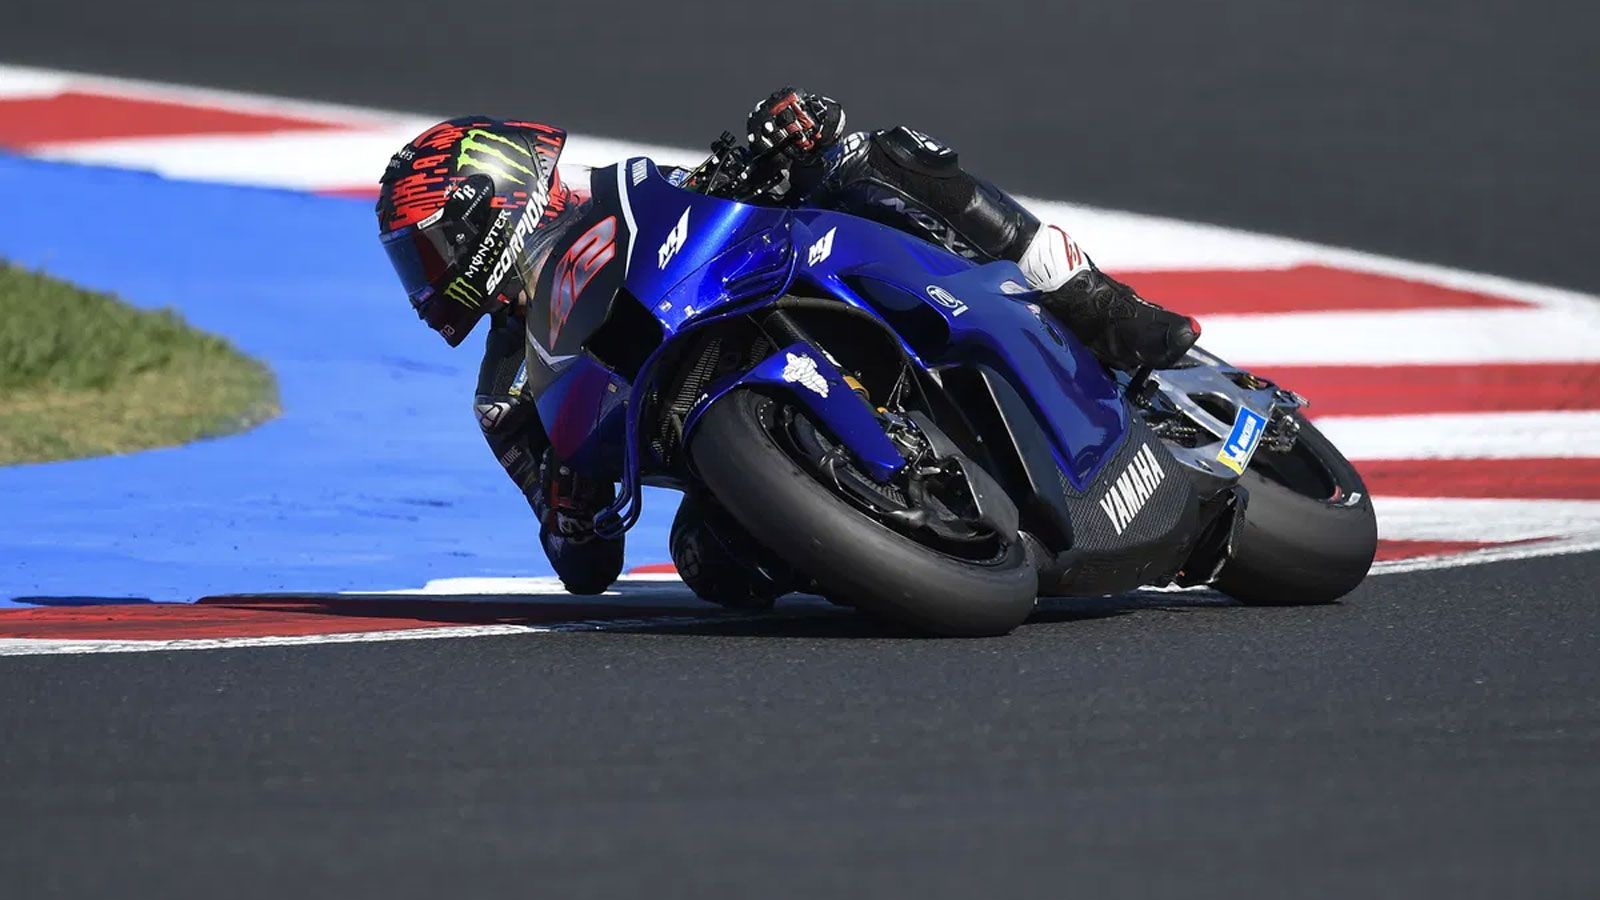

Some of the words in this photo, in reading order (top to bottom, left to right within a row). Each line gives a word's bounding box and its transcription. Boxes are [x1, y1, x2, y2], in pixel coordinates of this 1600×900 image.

[452, 184, 476, 201] TB
[464, 208, 512, 279] MONSTER
[486, 179, 550, 296] SCORPION
[1100, 442, 1165, 535] YAMAHA
